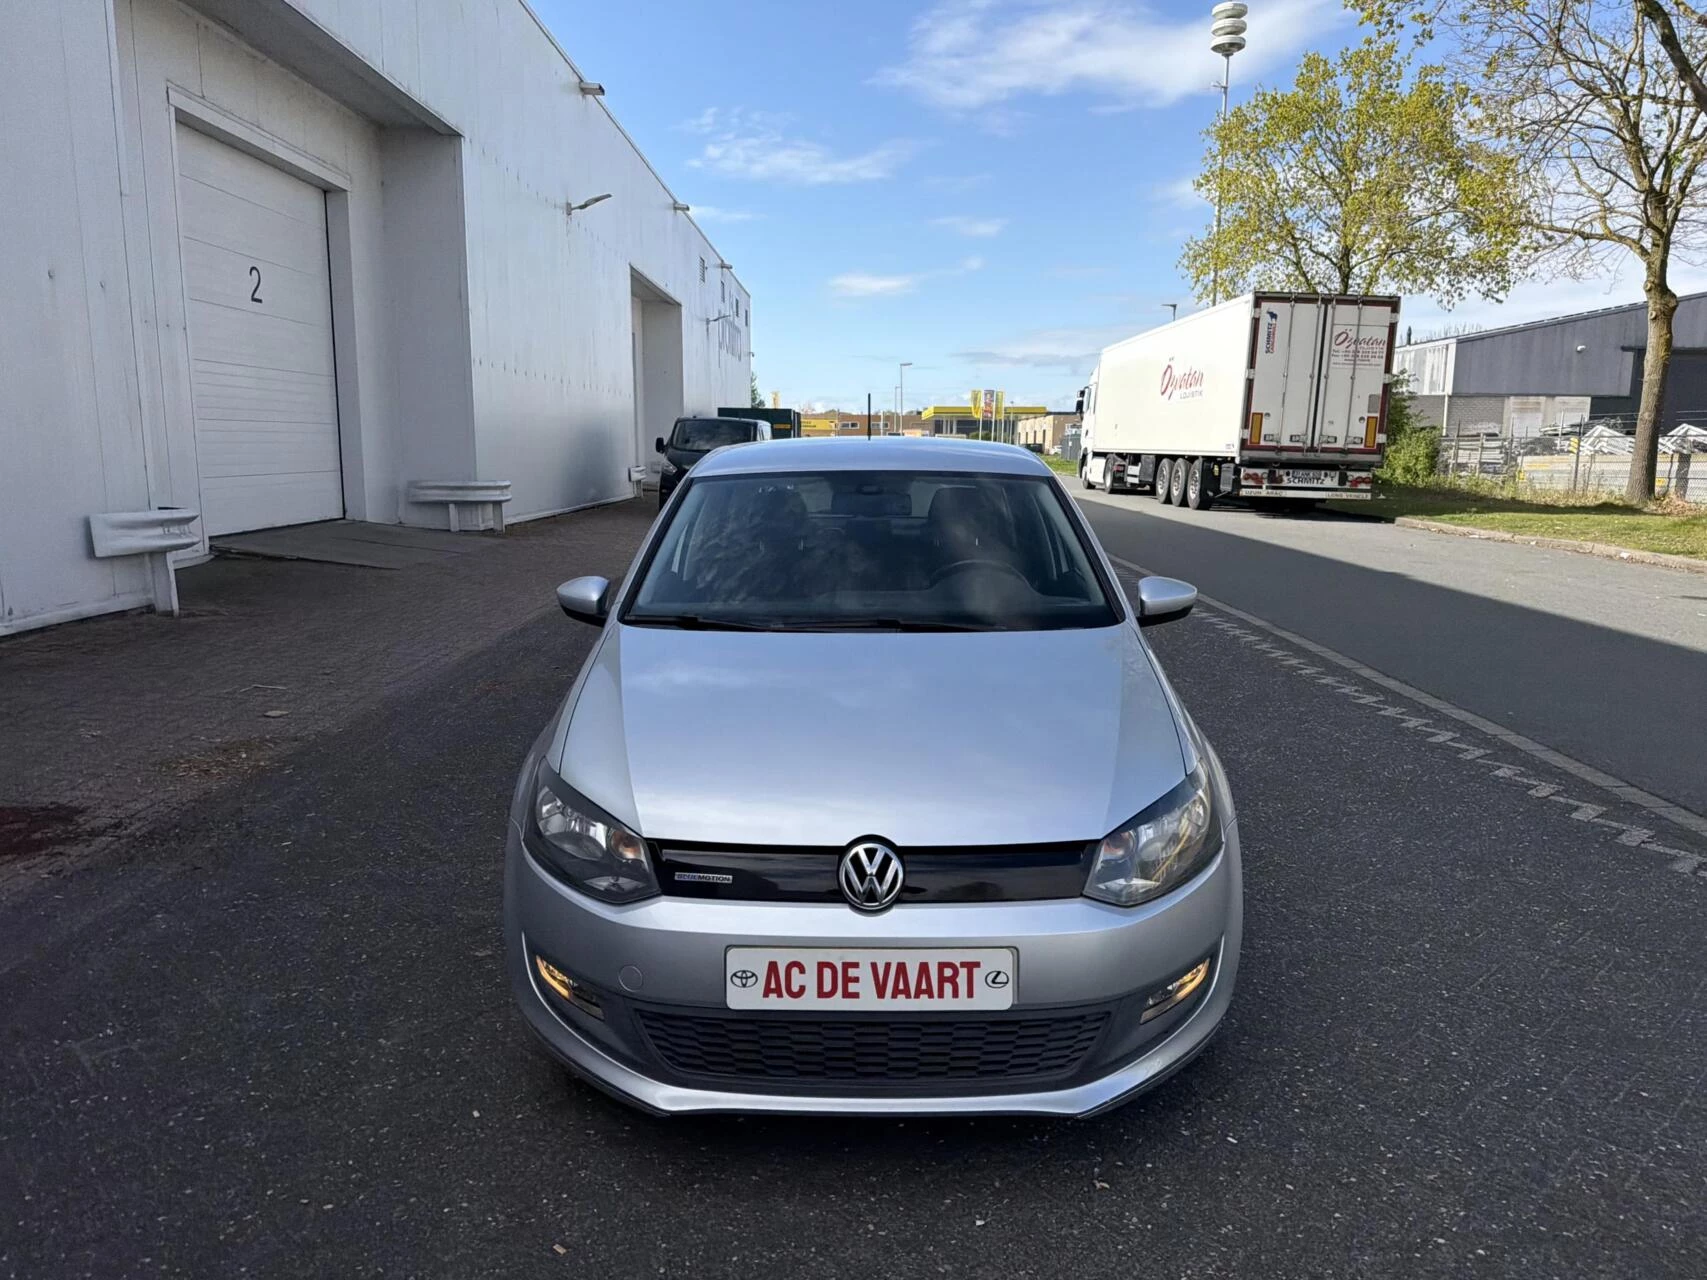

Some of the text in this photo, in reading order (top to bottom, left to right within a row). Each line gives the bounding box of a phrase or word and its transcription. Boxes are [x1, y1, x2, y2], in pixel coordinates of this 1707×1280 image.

[249, 266, 263, 304] 2
[1265, 322, 1273, 354] SCHMITZ
[1287, 477, 1325, 485] SCHMITZ
[677, 873, 731, 882] BLUEMOTION
[762, 960, 981, 1000] AC DE VAART
